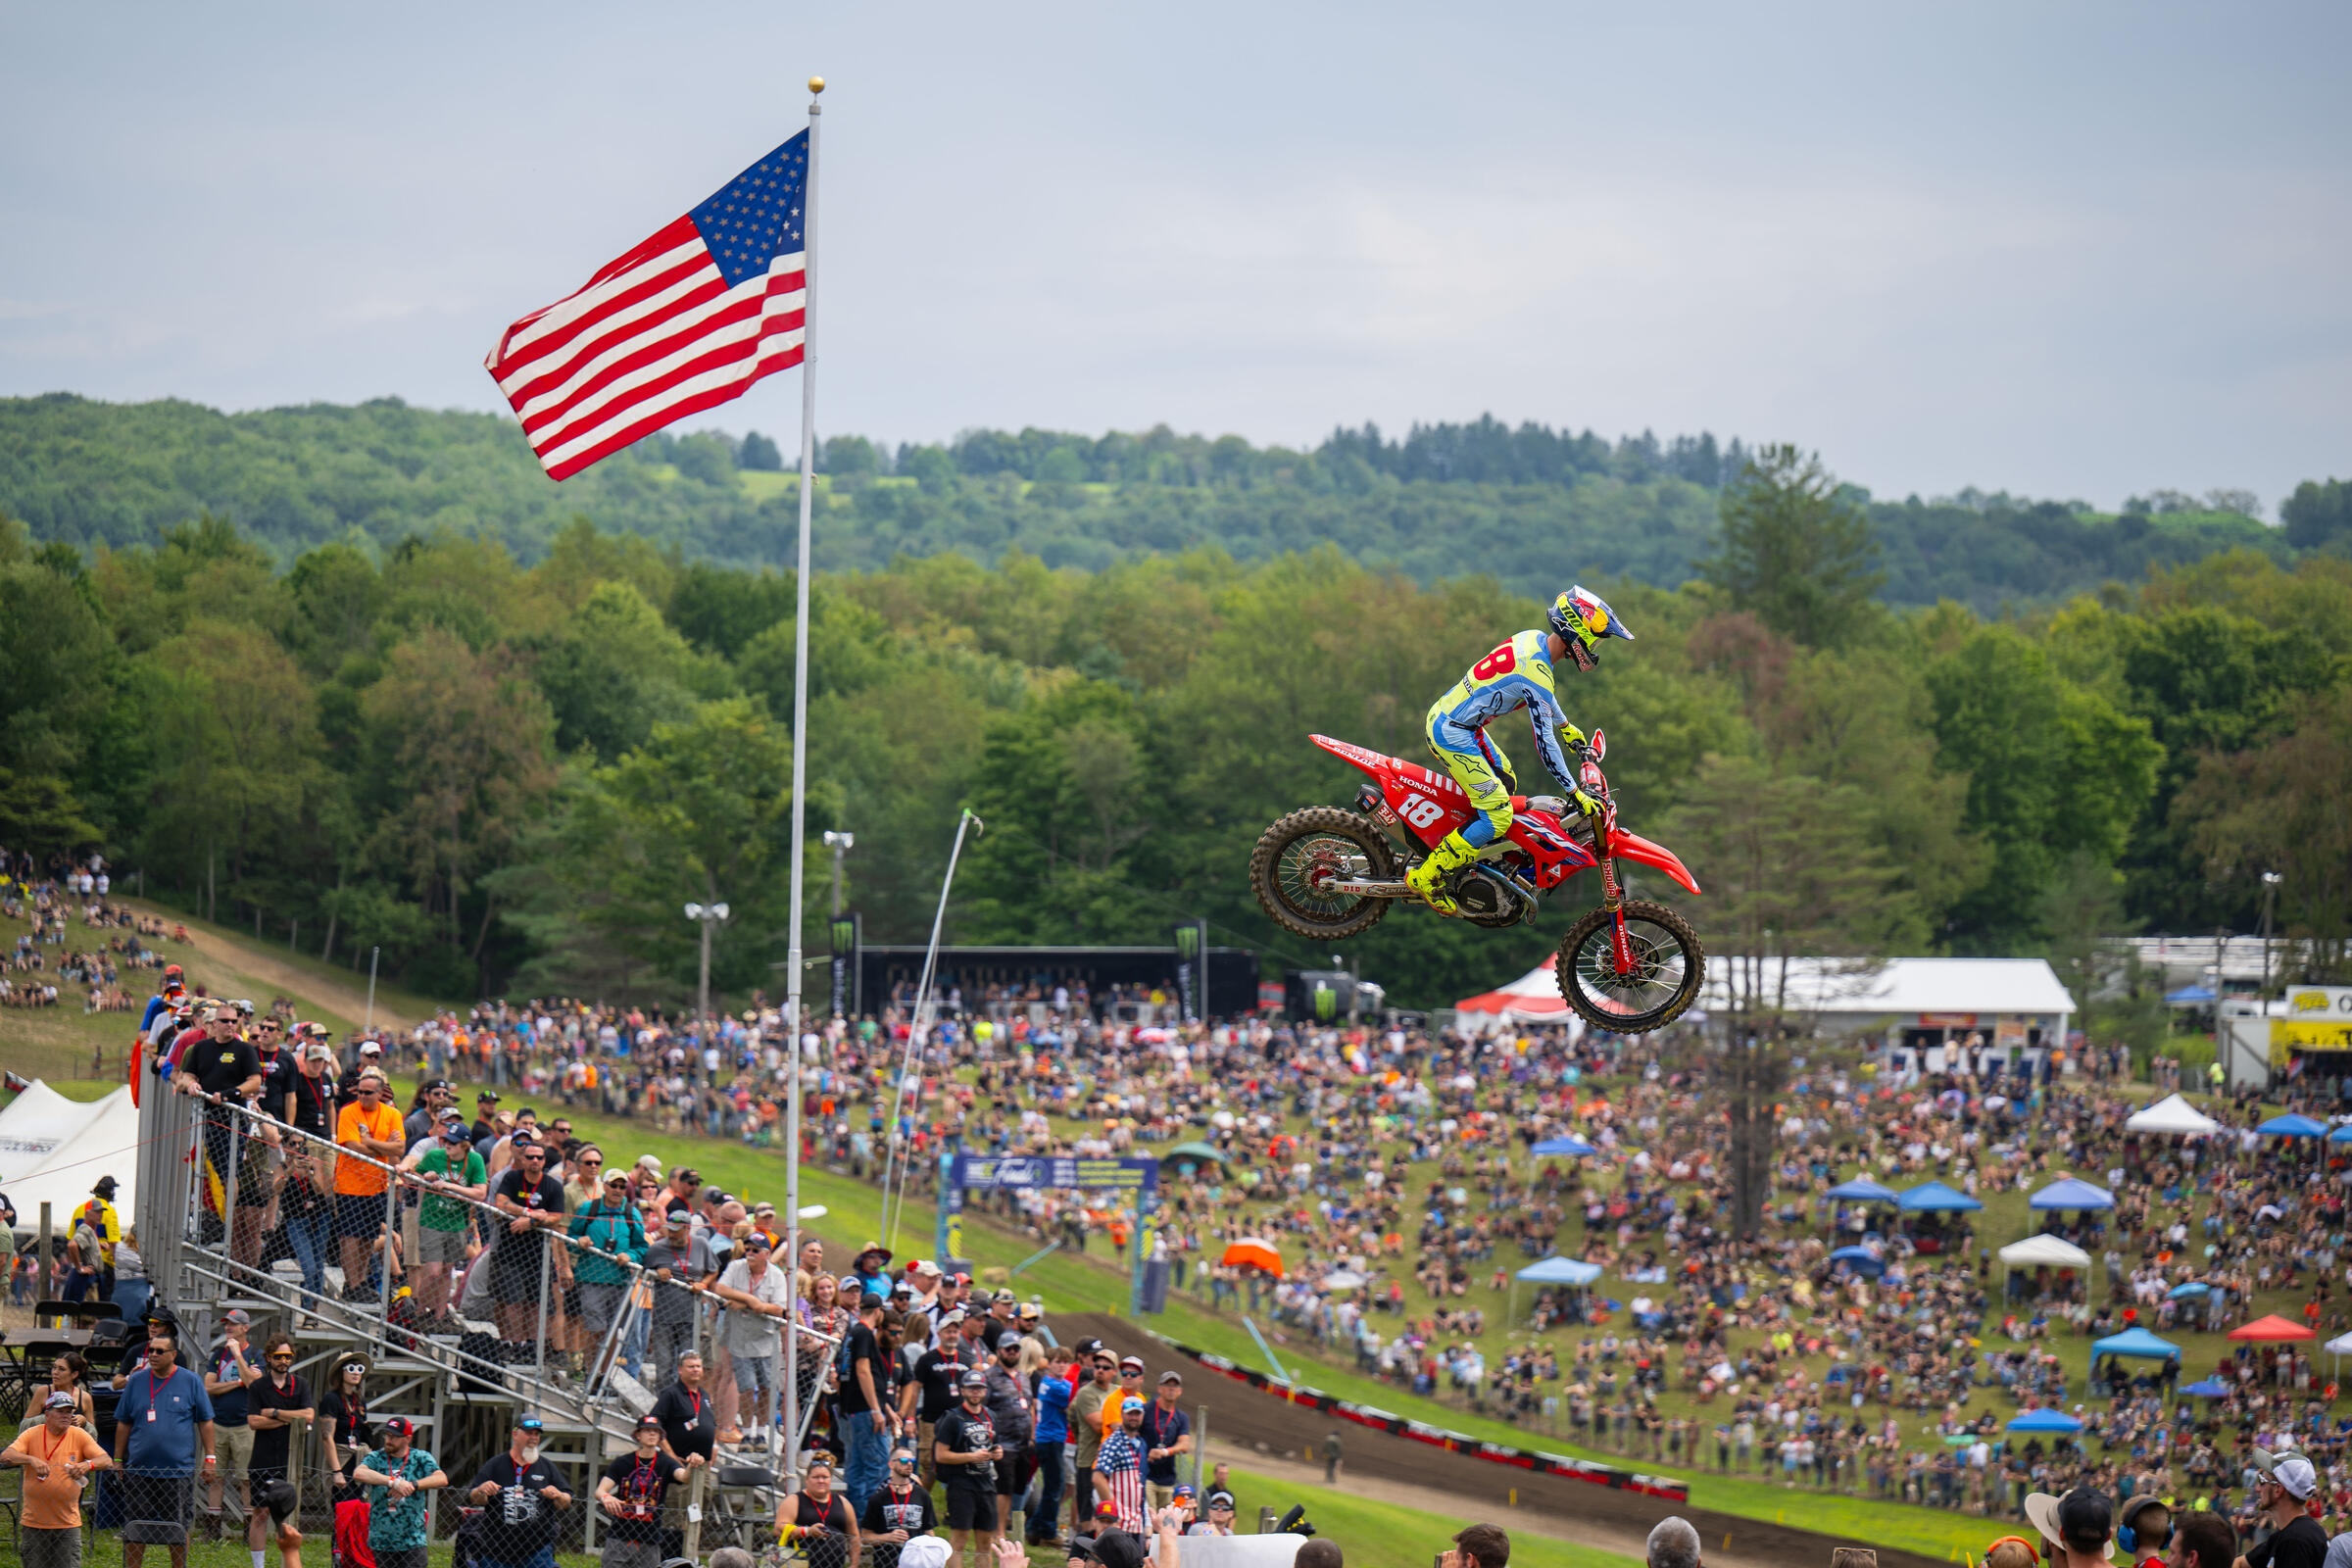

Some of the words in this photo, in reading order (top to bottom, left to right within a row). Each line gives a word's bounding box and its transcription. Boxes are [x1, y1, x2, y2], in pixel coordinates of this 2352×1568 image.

[1561, 605, 1593, 640] 100%
[1399, 775, 1438, 797] HONDA
[1397, 793, 1445, 829] 18
[1602, 862, 1617, 896] SHOWA
[1618, 924, 1630, 963] DUNLOP
